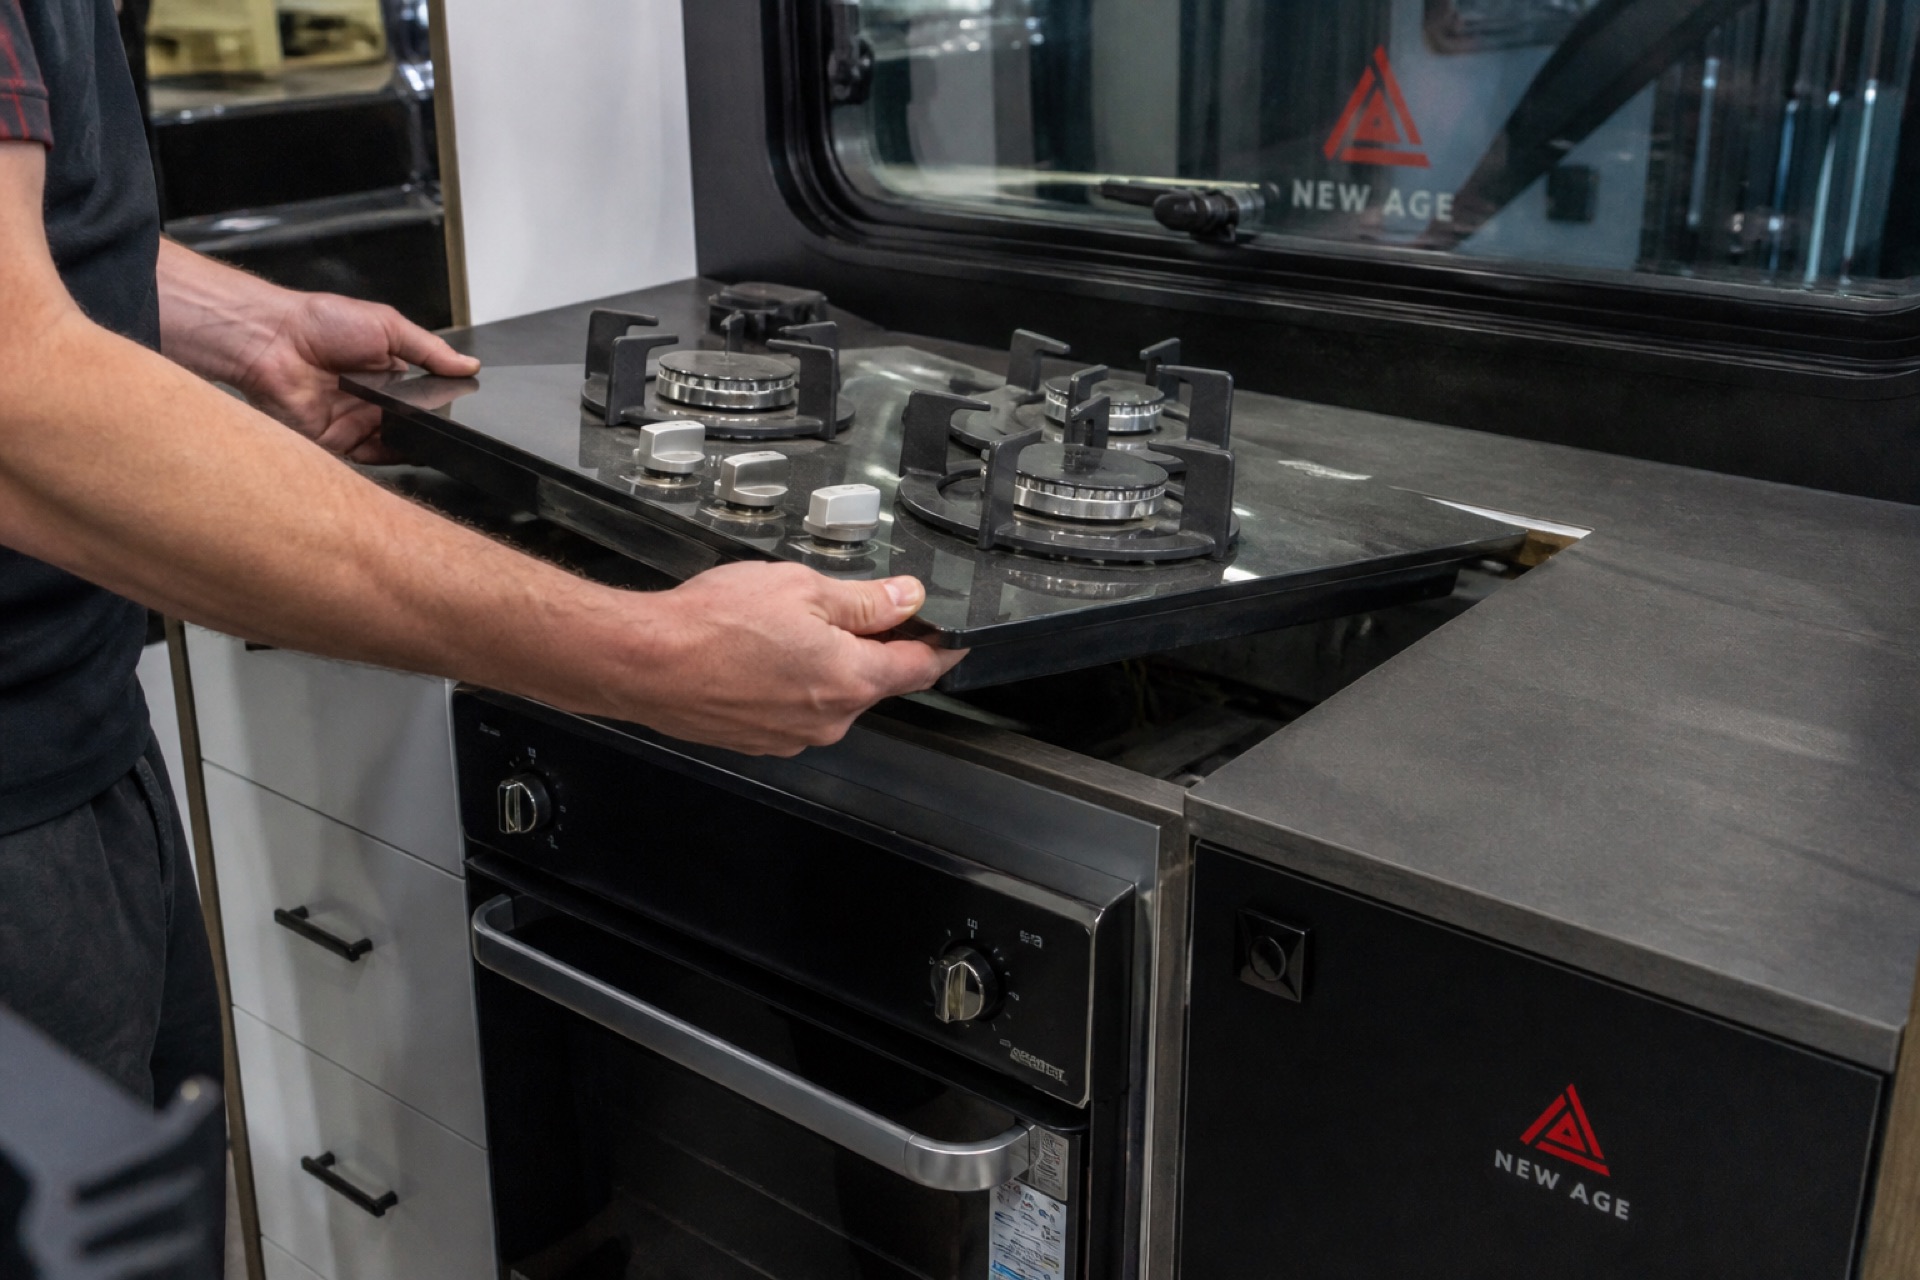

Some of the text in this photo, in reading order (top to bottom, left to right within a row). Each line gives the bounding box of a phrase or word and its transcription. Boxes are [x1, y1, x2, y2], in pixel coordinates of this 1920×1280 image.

[1291, 178, 1455, 222] NEW AGE
[1494, 1149, 1630, 1221] NEW AGE
